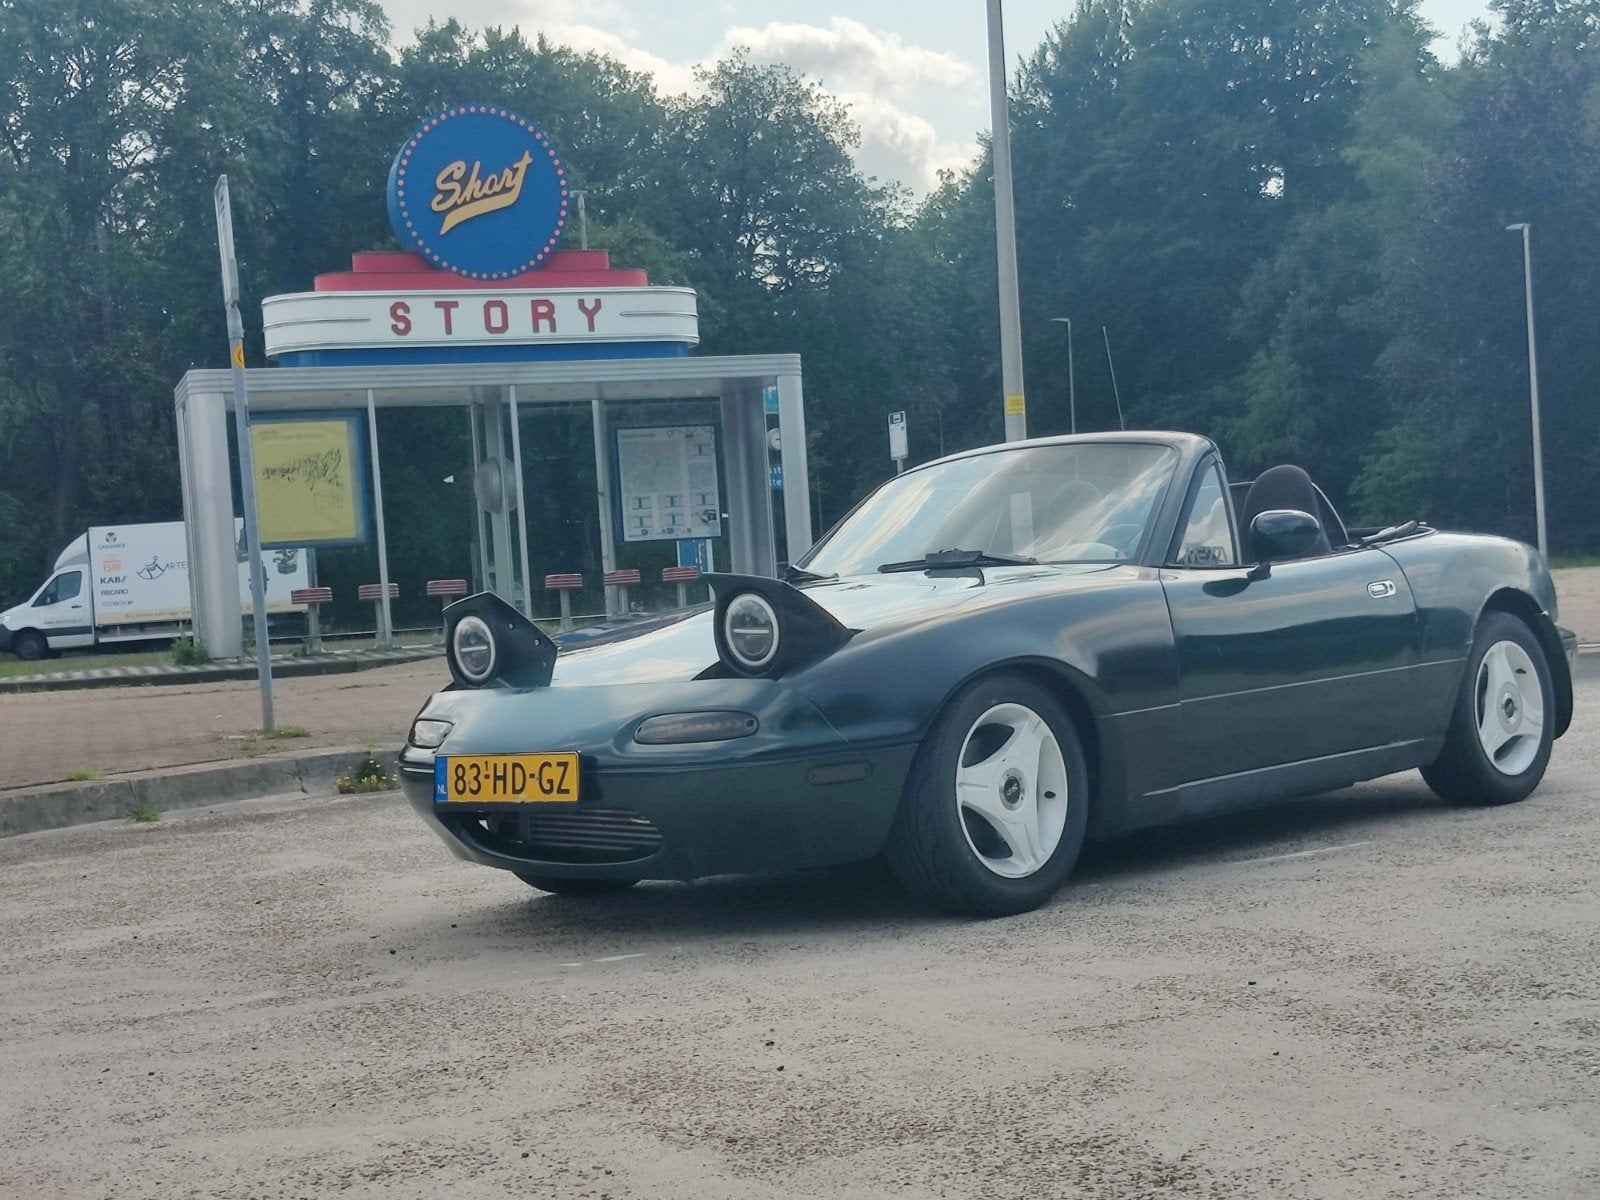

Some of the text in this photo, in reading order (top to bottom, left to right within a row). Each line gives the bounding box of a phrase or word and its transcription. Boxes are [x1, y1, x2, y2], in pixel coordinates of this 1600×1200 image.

[431, 150, 533, 235] Short
[389, 298, 602, 336] STORY
[437, 785, 447, 794] NL
[454, 761, 570, 795] 83-HD-GZ
